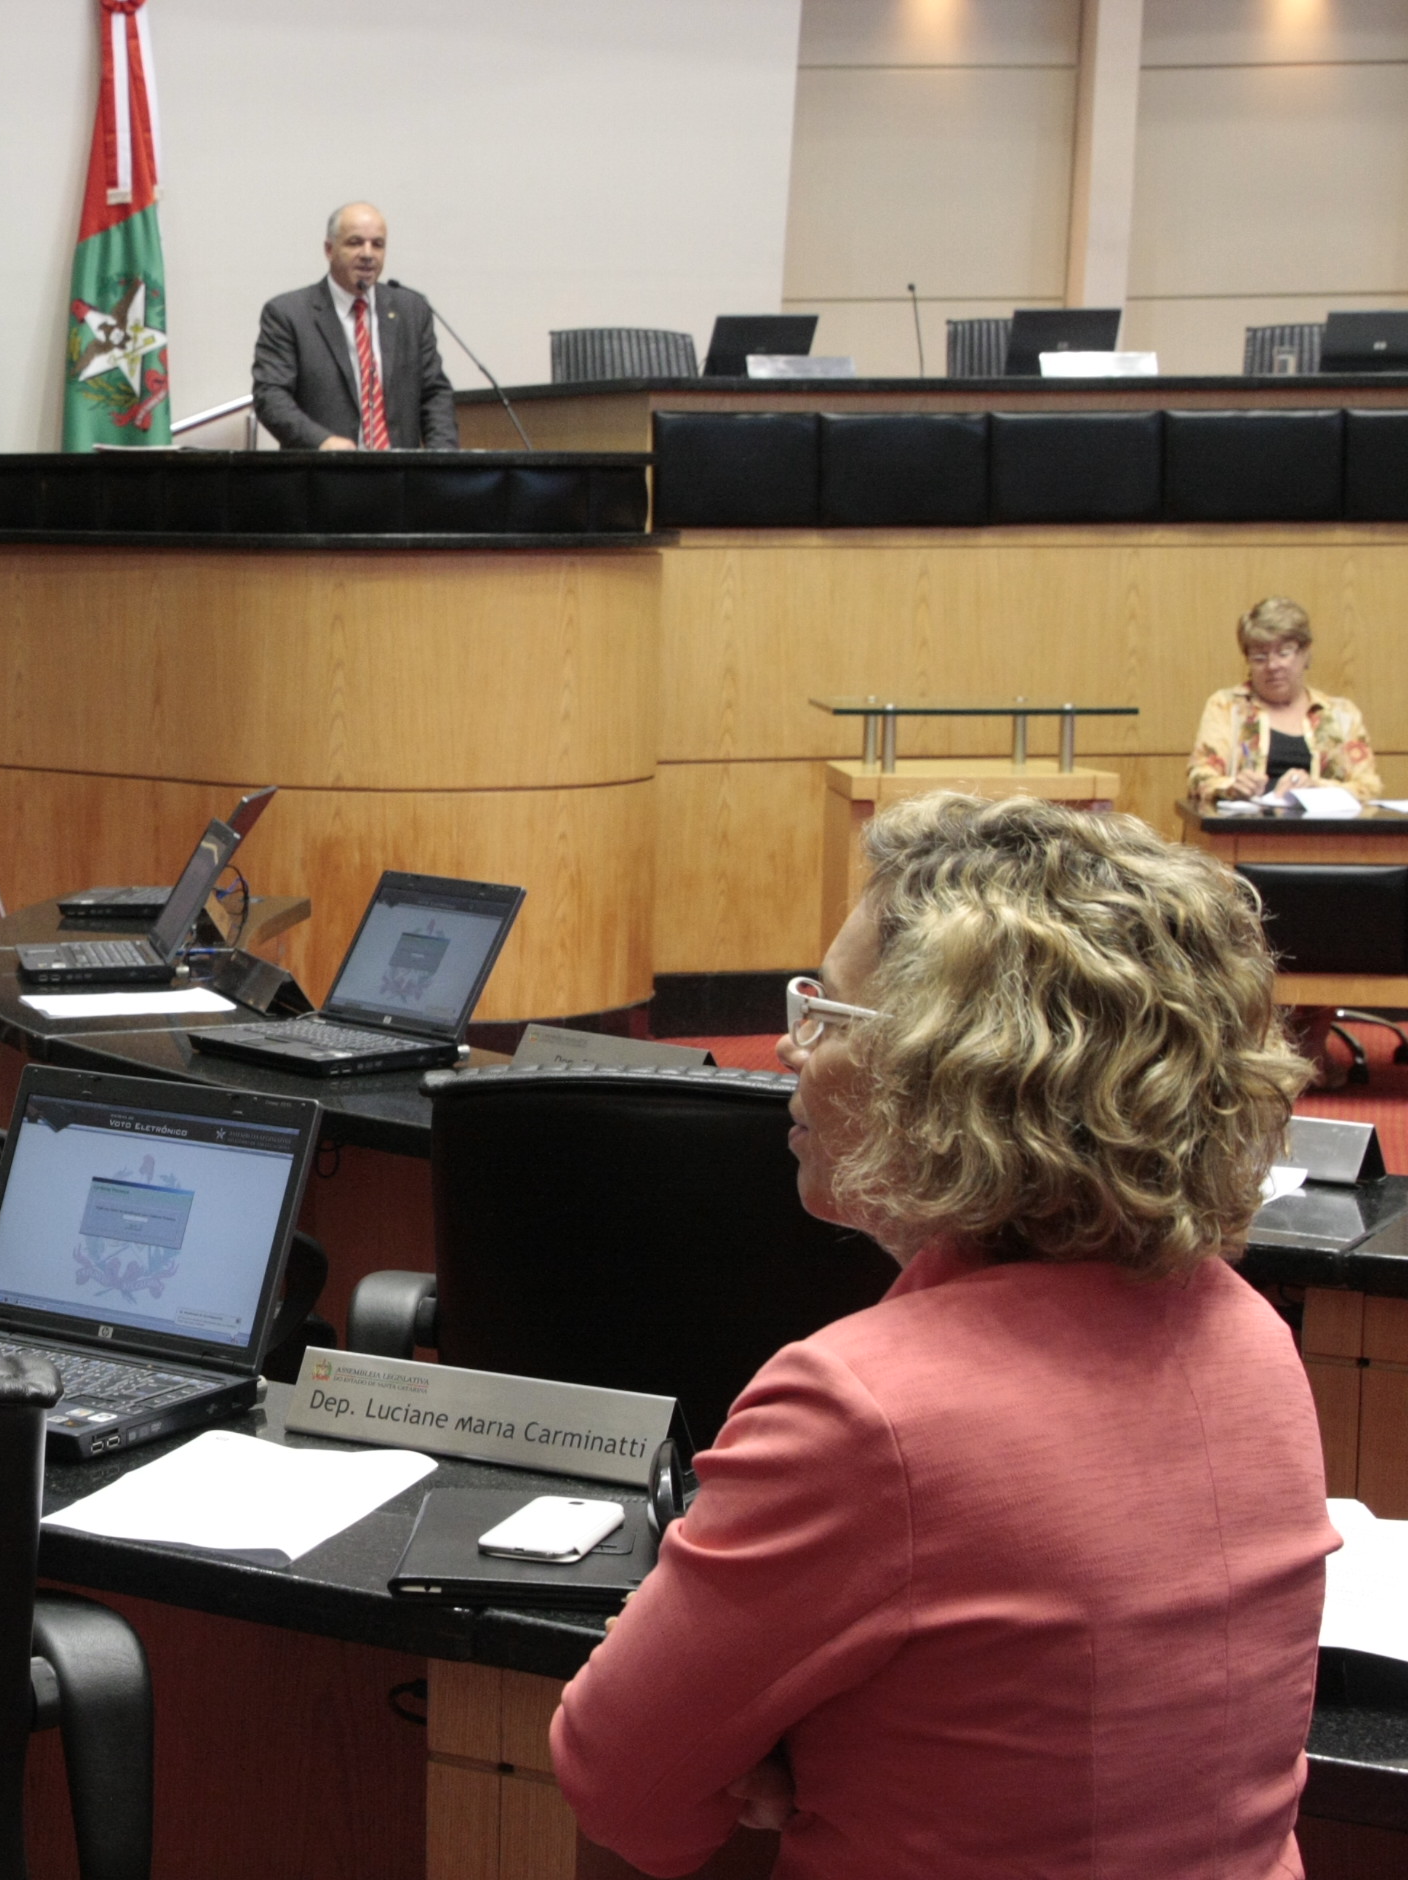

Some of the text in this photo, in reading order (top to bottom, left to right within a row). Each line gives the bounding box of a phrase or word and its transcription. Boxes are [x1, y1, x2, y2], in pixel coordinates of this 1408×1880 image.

[109, 1119, 132, 1129] VOTO
[309, 1389, 355, 1419] Dep.
[365, 1398, 449, 1429] Luciane
[524, 1421, 648, 1459] Carminatti
